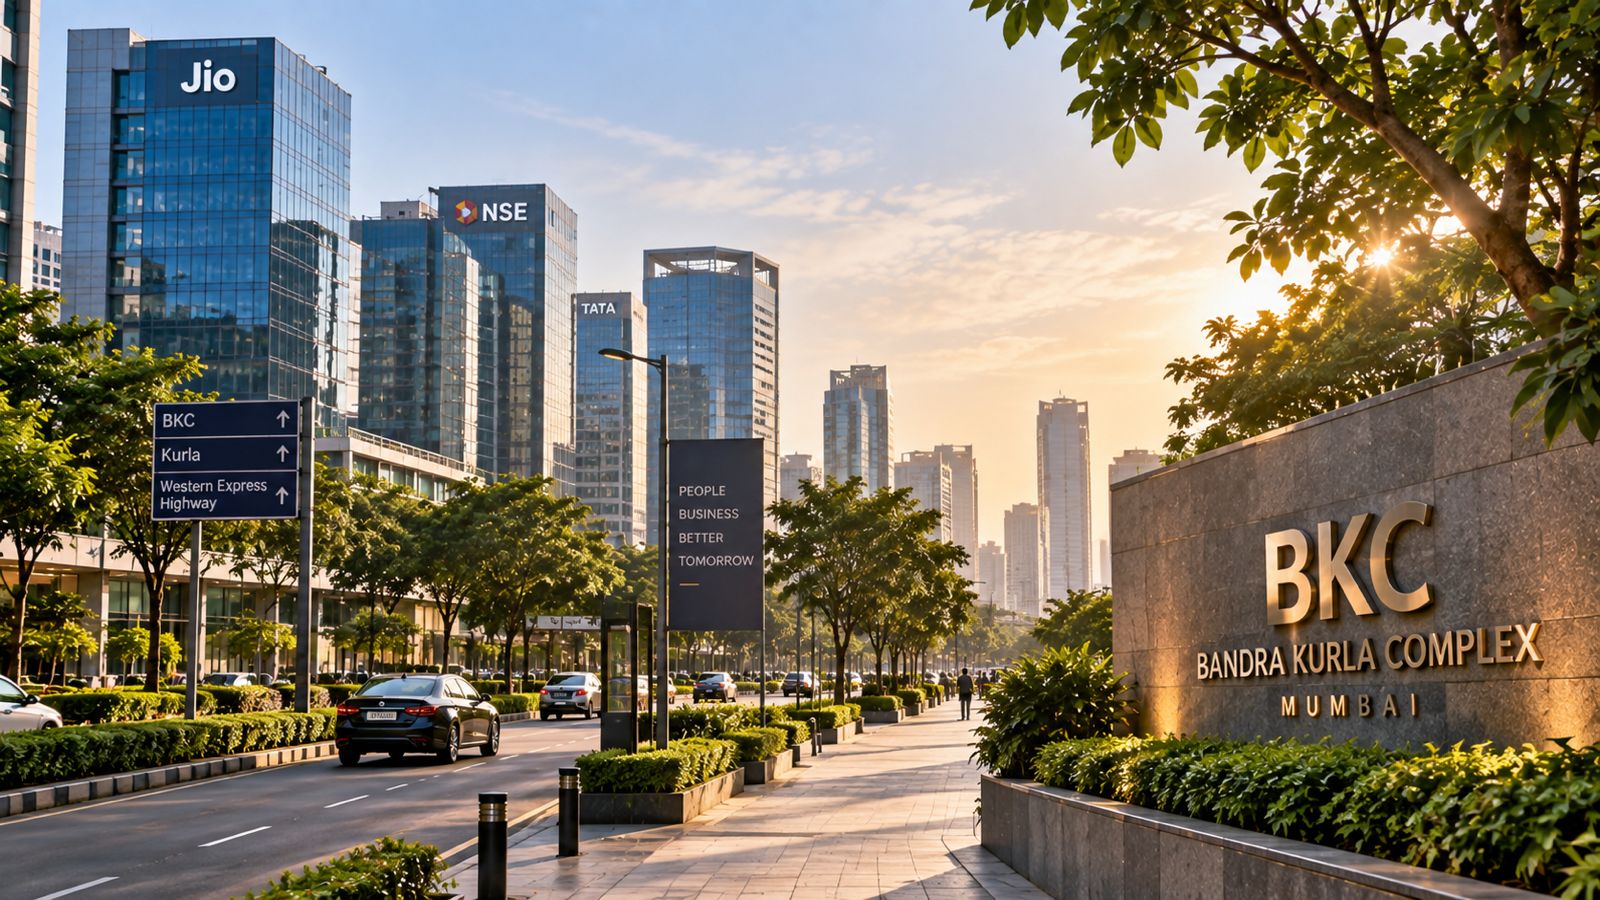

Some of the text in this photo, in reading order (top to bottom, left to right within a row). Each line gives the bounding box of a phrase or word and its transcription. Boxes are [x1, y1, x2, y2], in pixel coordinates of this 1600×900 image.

[181, 59, 236, 93] Jio
[482, 202, 528, 222] NSE
[581, 302, 616, 315] TATA
[163, 413, 195, 428] BKC
[161, 447, 201, 462] Kurla
[160, 479, 268, 495] Western Express
[679, 485, 726, 497] PEOPLE
[160, 496, 218, 513] Highway
[679, 508, 740, 520] BUSINESS
[679, 532, 724, 544] BETTER
[678, 555, 755, 567] TOMORROW
[1265, 500, 1433, 625] BKC
[1197, 622, 1545, 680] BANDRA KURLA COMPLEX
[1281, 692, 1418, 718] MUMBAI
